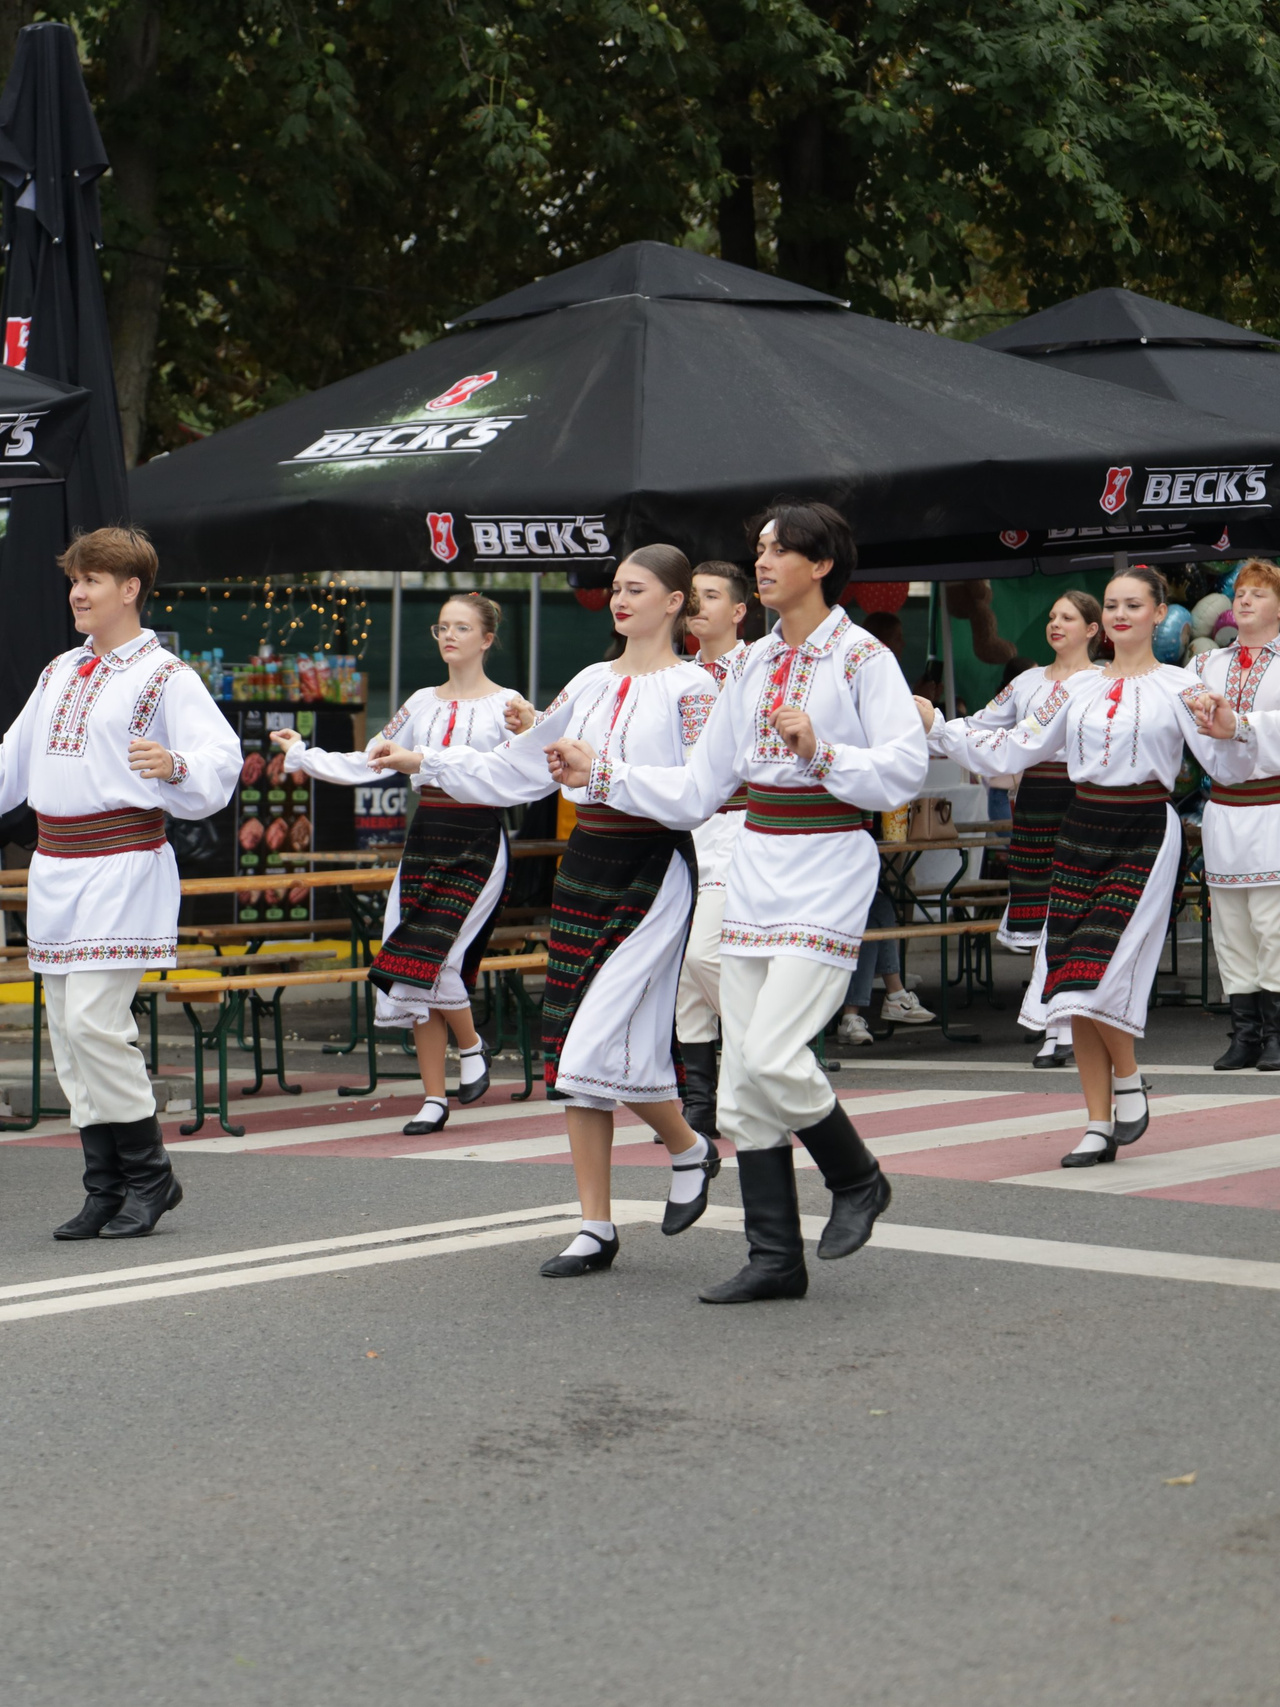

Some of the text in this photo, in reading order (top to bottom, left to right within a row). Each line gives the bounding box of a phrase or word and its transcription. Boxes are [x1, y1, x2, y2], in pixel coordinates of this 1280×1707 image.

[293, 417, 512, 460] BECK'S
[1142, 465, 1266, 505] BECK'S
[471, 516, 611, 555] BECK'S
